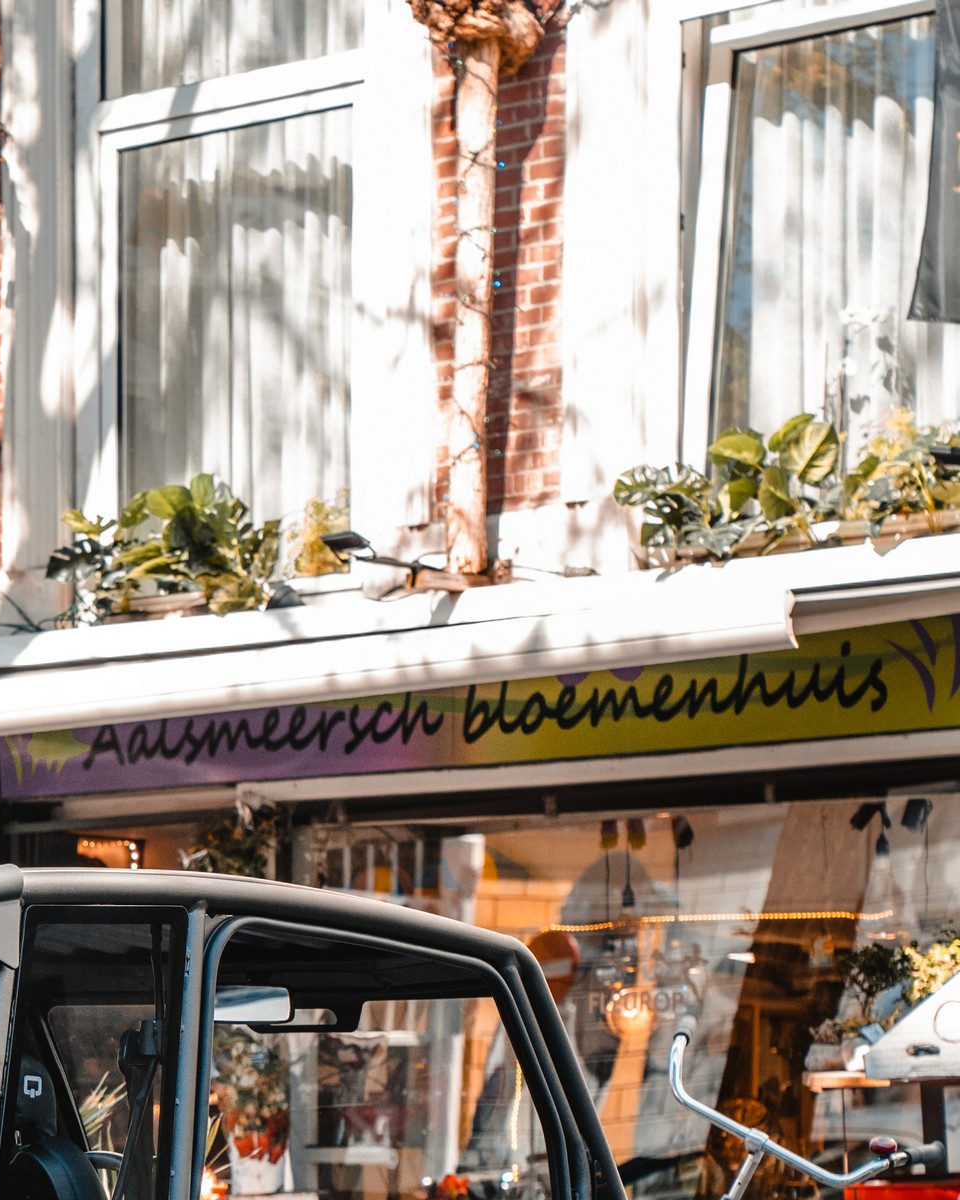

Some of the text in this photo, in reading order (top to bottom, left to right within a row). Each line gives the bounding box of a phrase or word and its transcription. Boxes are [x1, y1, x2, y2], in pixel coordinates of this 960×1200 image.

[82, 640, 889, 770] Aalsmeersch bloemenhuis
[588, 991, 685, 1015] FLUROP
